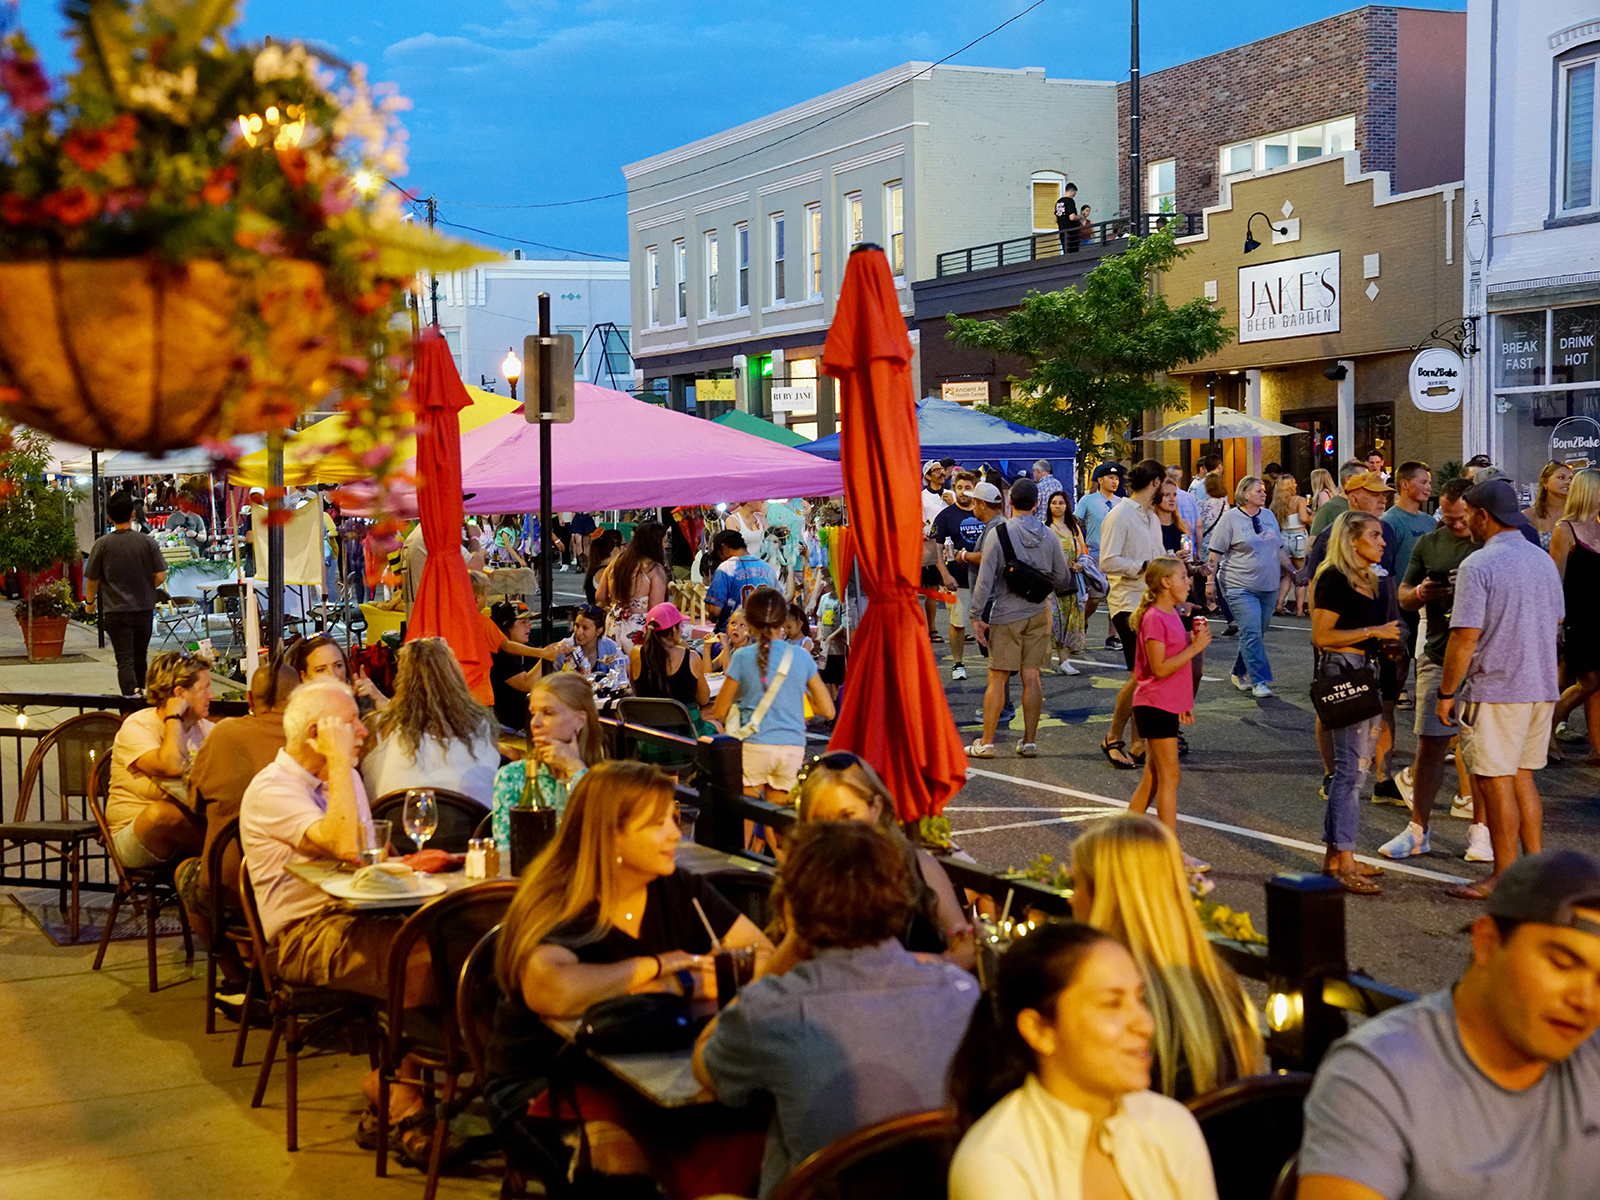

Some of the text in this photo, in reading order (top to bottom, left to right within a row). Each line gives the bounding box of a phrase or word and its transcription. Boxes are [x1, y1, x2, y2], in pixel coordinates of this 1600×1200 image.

[1242, 267, 1336, 320] JAKE'S
[1247, 309, 1331, 332] BEER GARDEN
[1502, 340, 1538, 355] BREAK
[1560, 335, 1595, 350] DRINK
[1505, 357, 1534, 370] FAST
[1565, 352, 1589, 366] HOT
[1418, 367, 1458, 377] Born2Bake
[773, 392, 813, 401] RUBY JANE
[1553, 436, 1600, 449] Born2Bake
[1321, 691, 1346, 703] TOTE
[1348, 684, 1369, 696] BAG
[1333, 682, 1352, 692] THE
